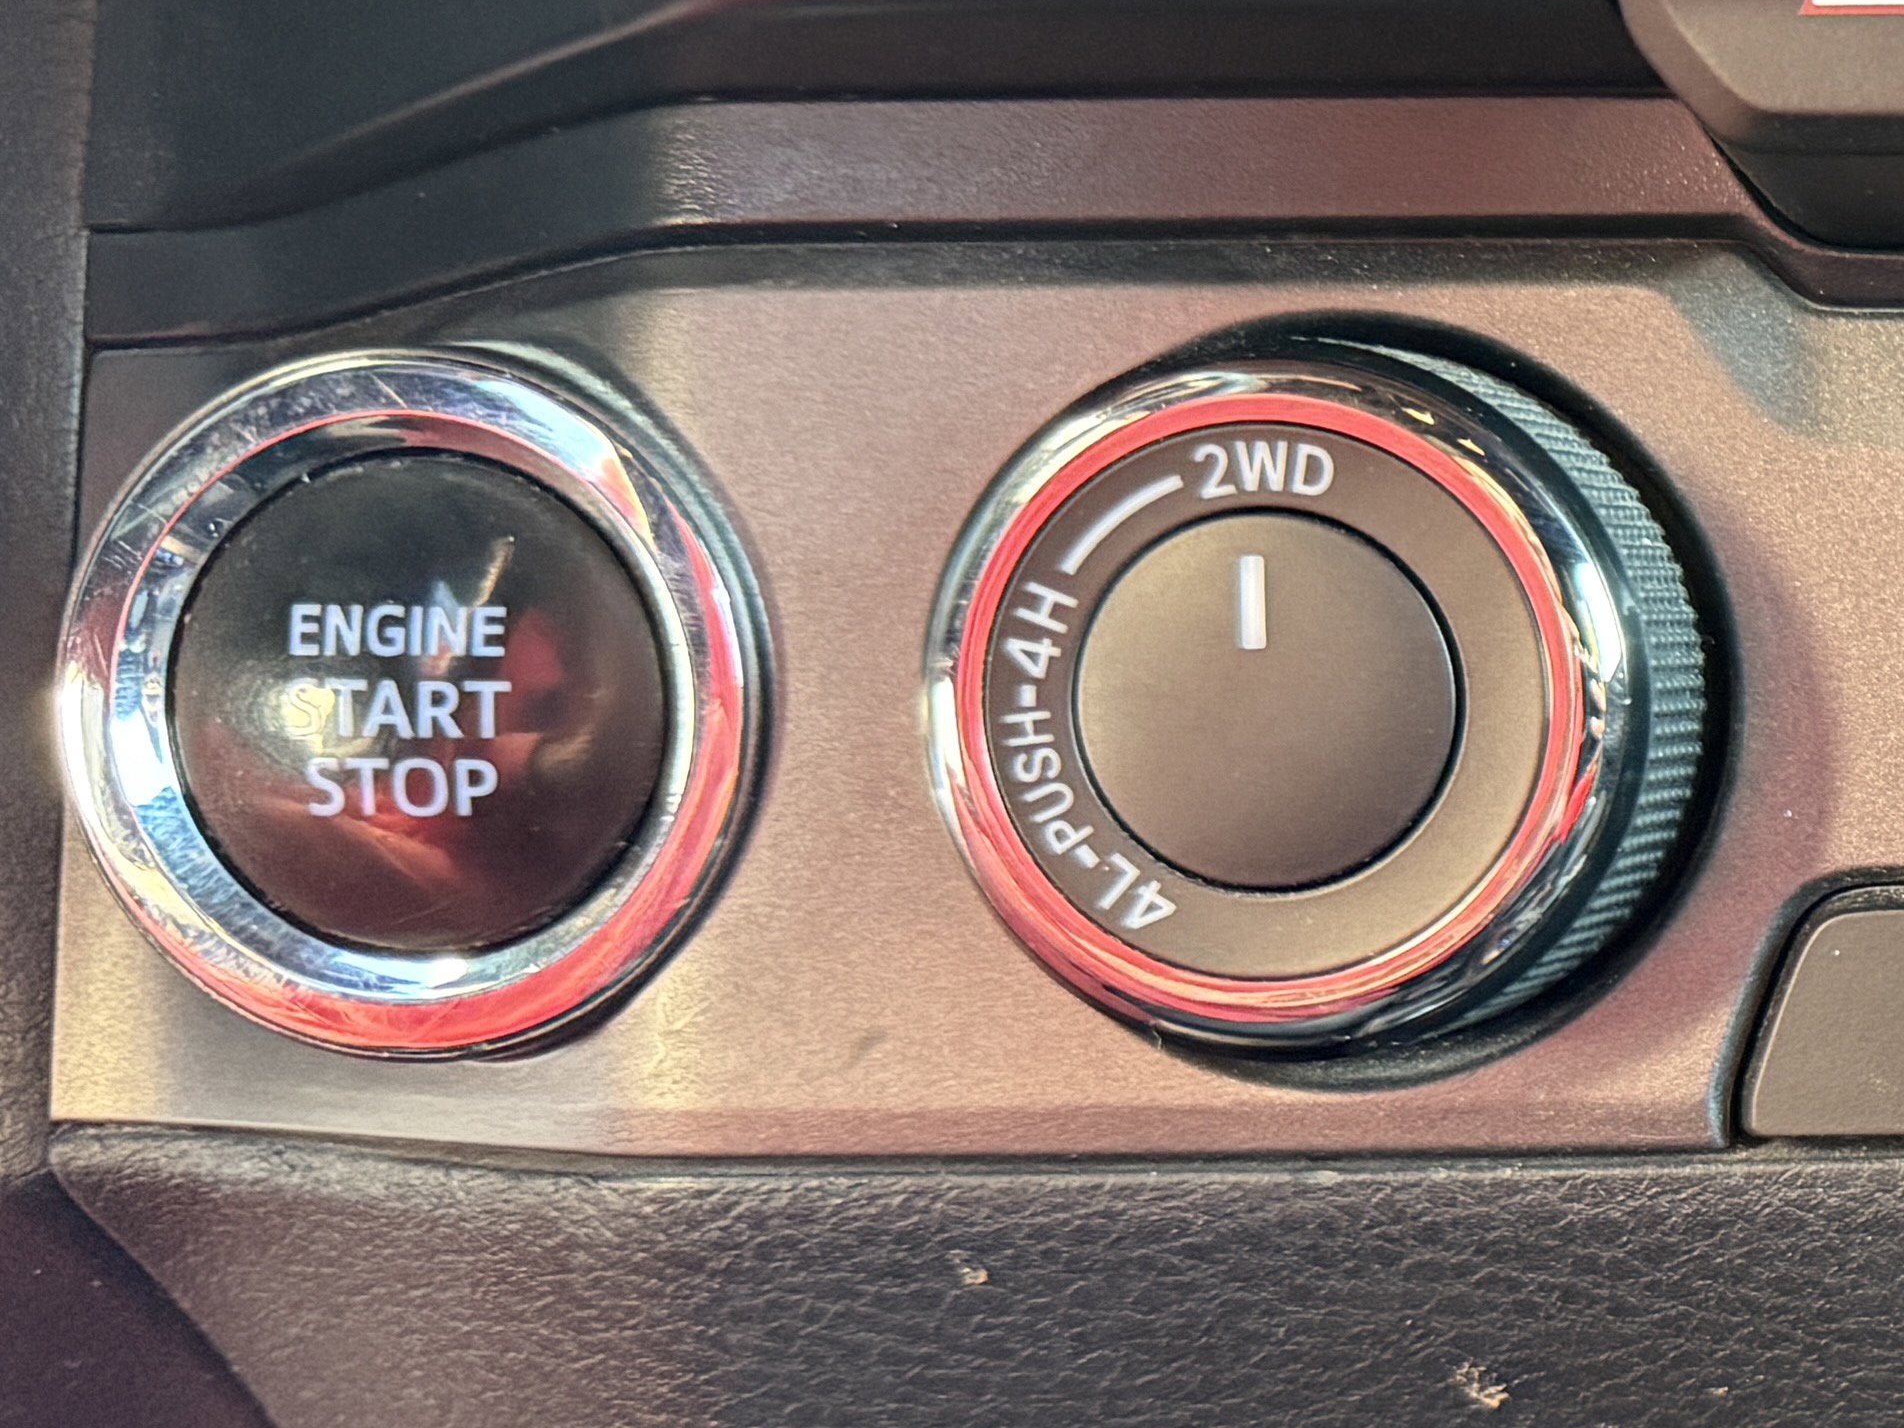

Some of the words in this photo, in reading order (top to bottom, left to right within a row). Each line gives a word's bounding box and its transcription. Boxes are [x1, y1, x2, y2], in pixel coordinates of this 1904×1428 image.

[1193, 440, 1335, 500] 2WD
[289, 603, 508, 657] ENGINE
[282, 677, 512, 739] START
[305, 757, 498, 817] STOP
